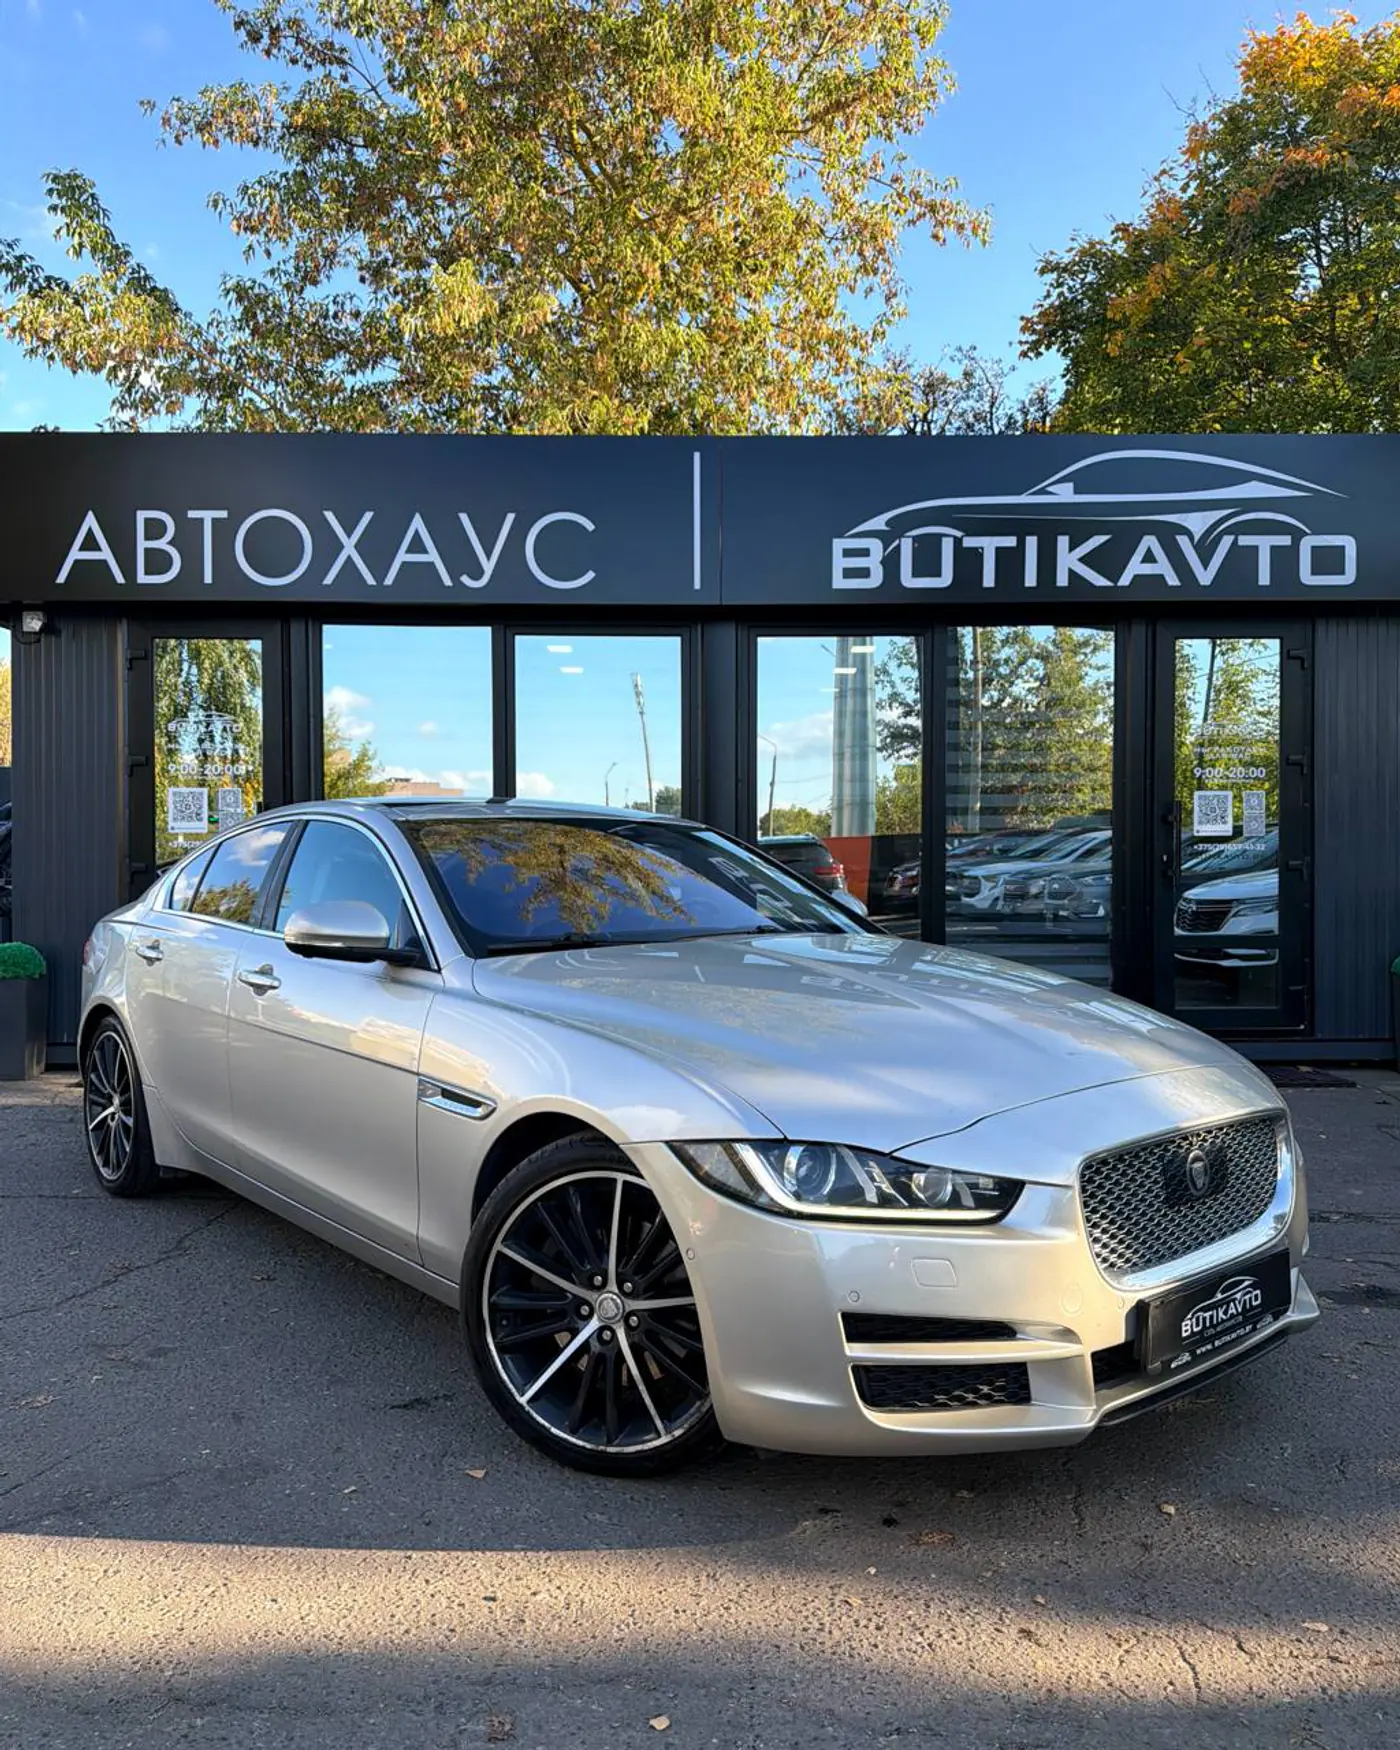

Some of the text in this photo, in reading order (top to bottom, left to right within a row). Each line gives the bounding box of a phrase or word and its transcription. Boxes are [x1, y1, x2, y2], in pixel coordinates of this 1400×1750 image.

[55, 508, 596, 589] АВТОХАУС
[831, 534, 1358, 589] BUTIKAVTO
[1193, 766, 1266, 779] 9:00-20:00
[1181, 1289, 1262, 1338] BUTIKAVTO
